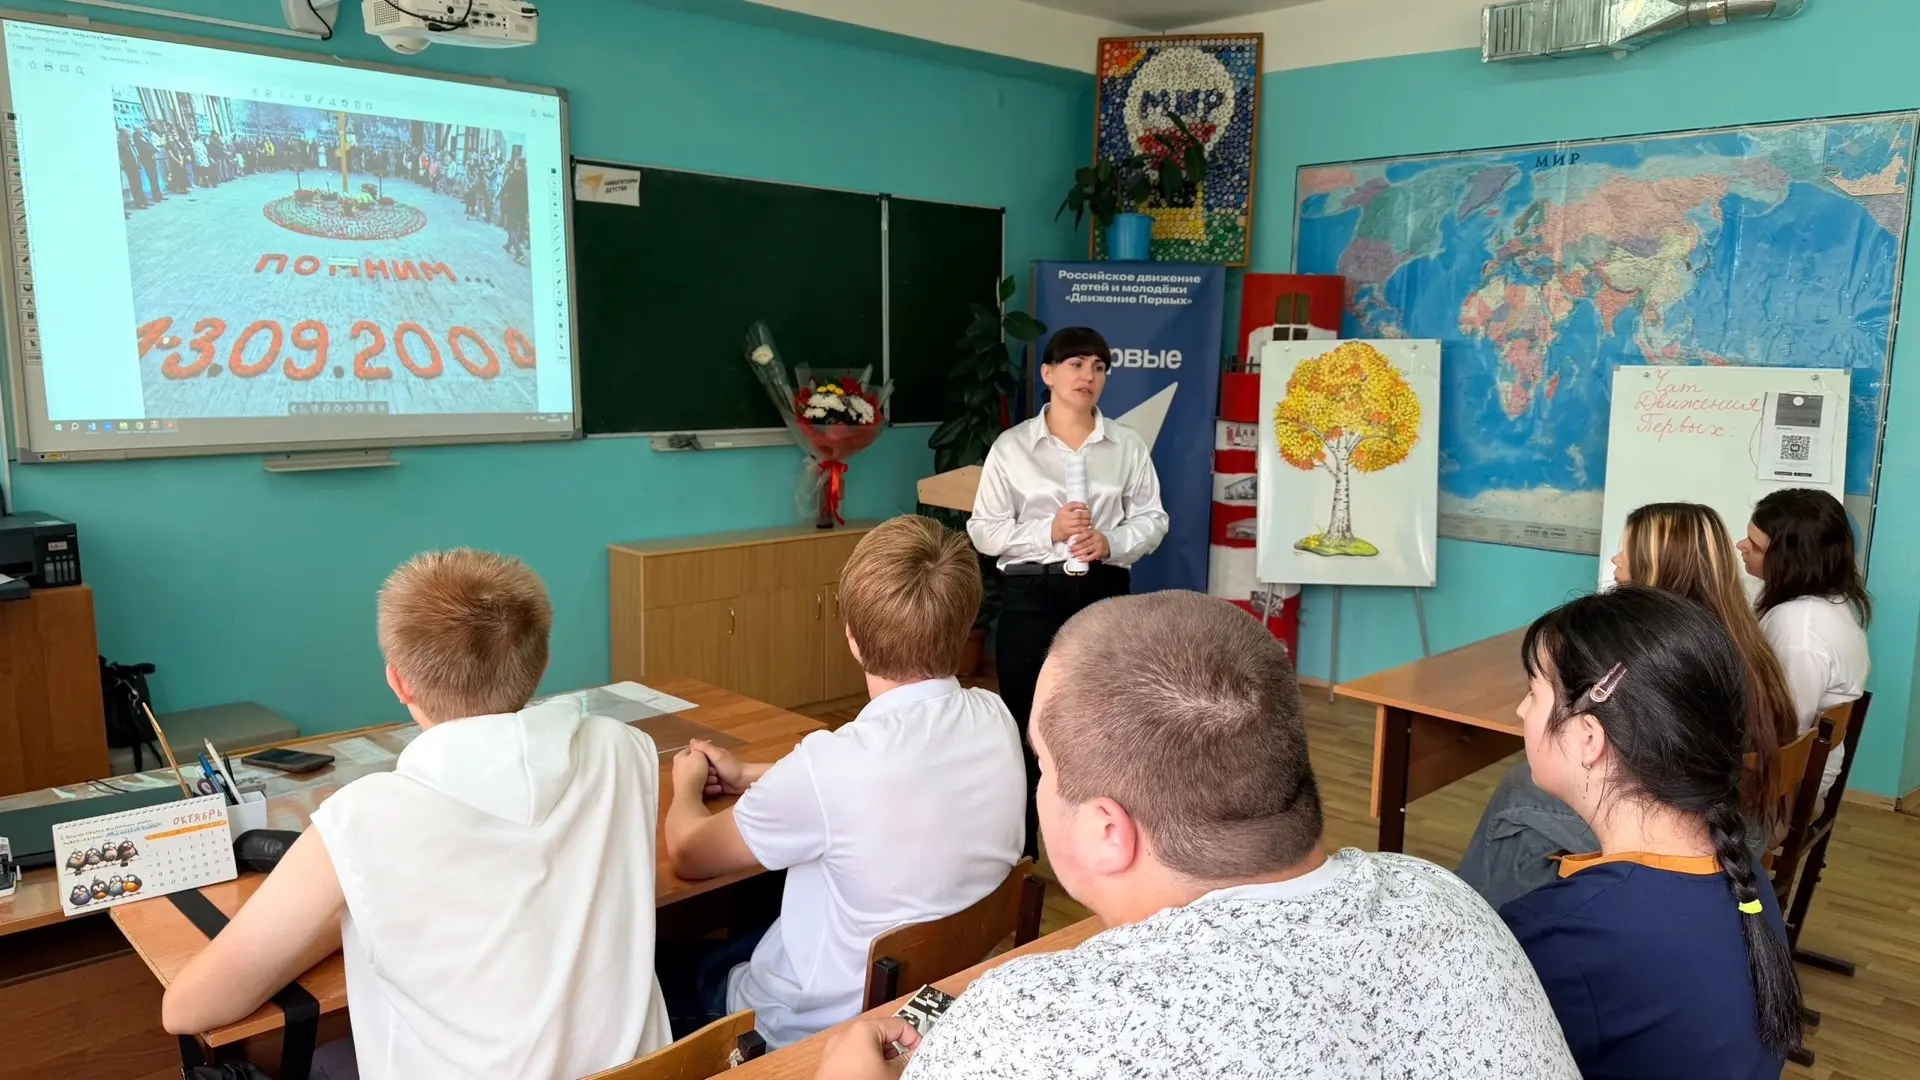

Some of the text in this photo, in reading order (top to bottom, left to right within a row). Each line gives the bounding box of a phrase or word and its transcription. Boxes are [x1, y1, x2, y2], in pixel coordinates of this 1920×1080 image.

[1141, 88, 1223, 122] МИР
[1534, 152, 1580, 168] МИР
[1058, 270, 1201, 283] Российское движение
[1071, 283, 1188, 294] детей и молодёжи
[1065, 293, 1193, 306] «Движение Первых»
[1106, 348, 1183, 375] рвые
[1654, 369, 1703, 393] Чат
[1634, 391, 1763, 411] Движения
[173, 808, 223, 825] ОКТЯБРЬ
